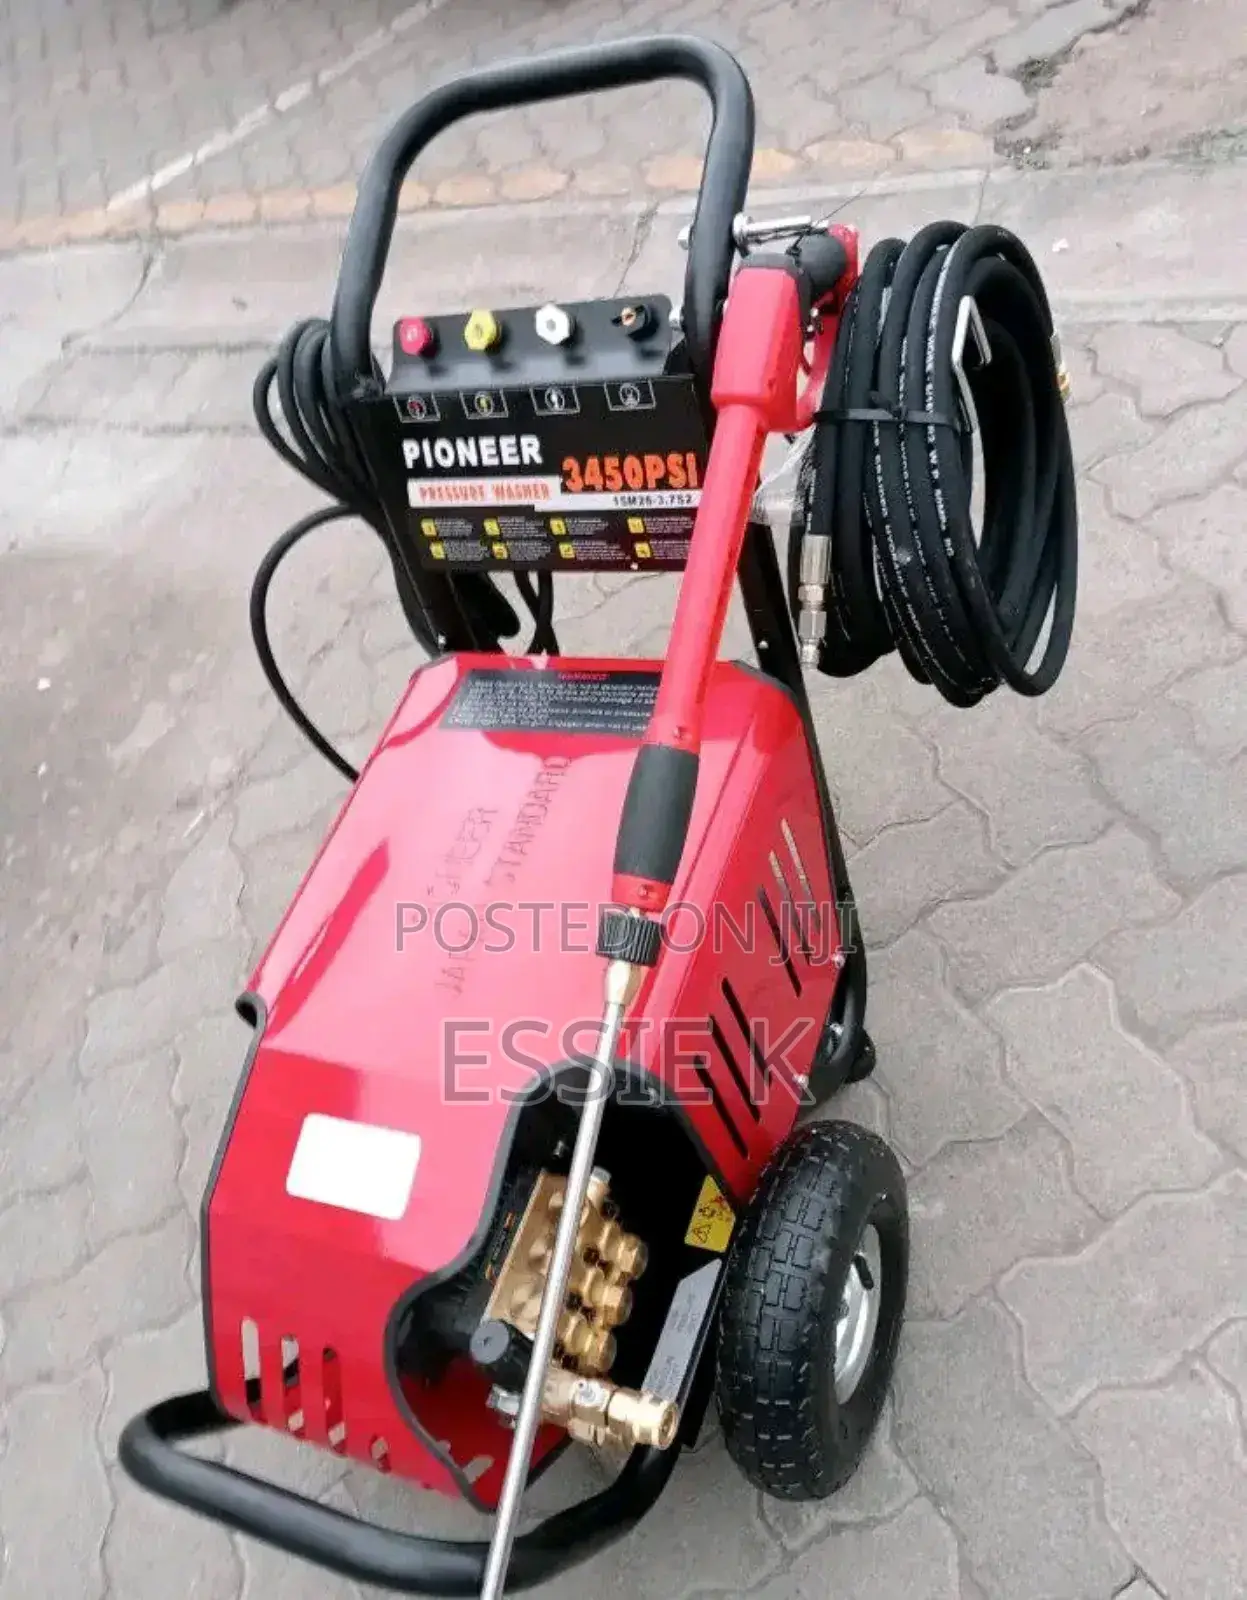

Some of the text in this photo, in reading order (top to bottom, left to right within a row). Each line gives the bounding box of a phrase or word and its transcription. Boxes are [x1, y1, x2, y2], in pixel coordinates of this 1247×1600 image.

[402, 434, 544, 469] PIONEER
[562, 452, 698, 492] 3450PSI
[419, 481, 552, 503] PRESSURE WASHER
